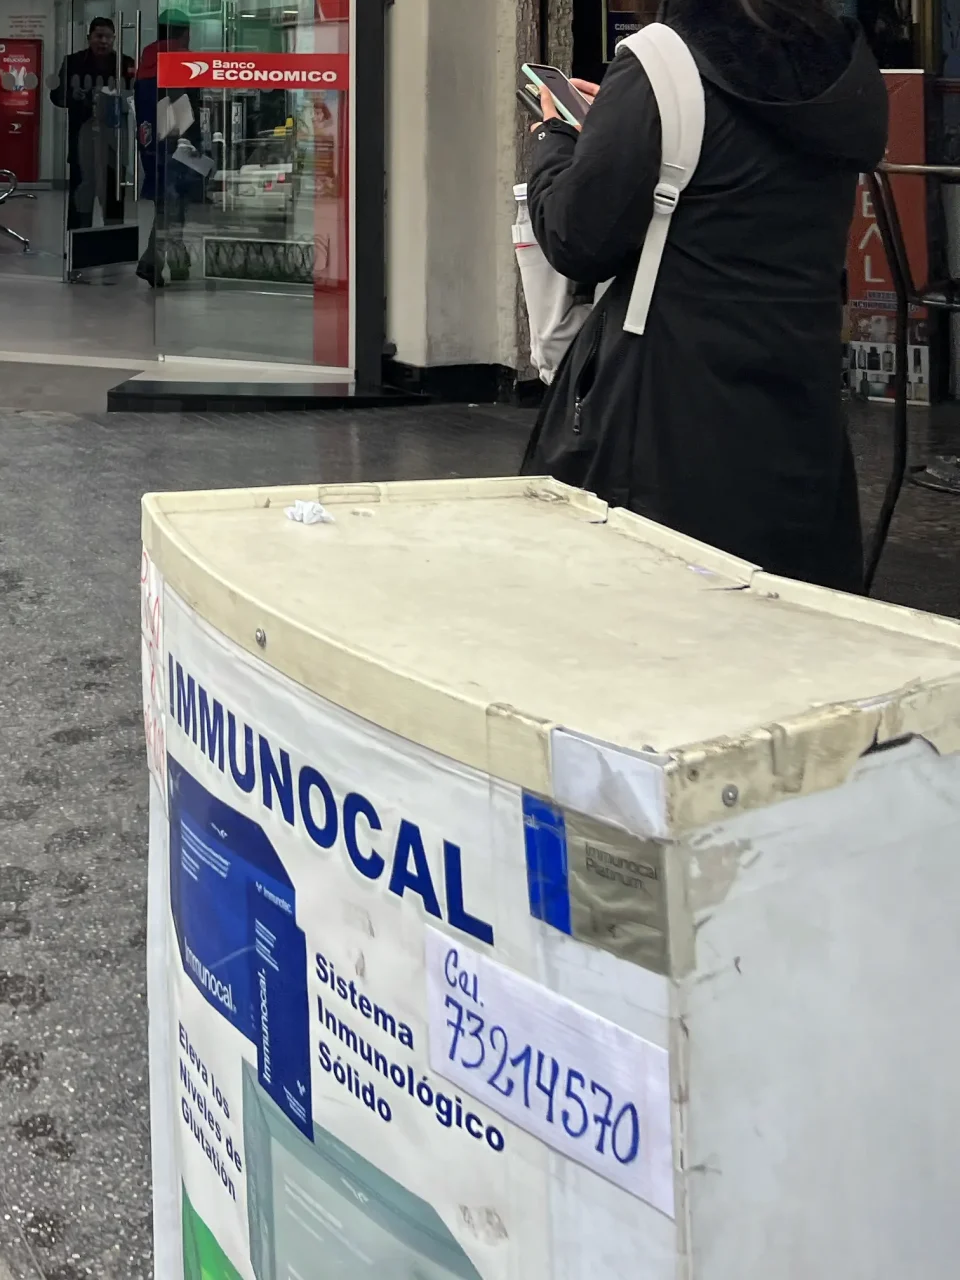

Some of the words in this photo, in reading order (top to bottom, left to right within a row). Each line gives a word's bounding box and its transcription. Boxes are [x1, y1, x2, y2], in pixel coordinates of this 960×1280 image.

[212, 59, 255, 69] Banco
[212, 70, 337, 82] ECONOMICO
[168, 651, 495, 947] IMMUNOCAL
[585, 841, 658, 880] Immunocal
[585, 856, 643, 890] Platinum
[315, 951, 415, 1051] Sistema
[178, 1019, 209, 1088] Eleva
[211, 1073, 231, 1120] los
[179, 1056, 222, 1142] Niveles
[225, 1135, 243, 1173] de
[316, 994, 506, 1153] Inmunológico
[318, 1039, 392, 1123] Sólido
[444, 994, 641, 1165] 73214570
[181, 1096, 237, 1203] Glutatión
